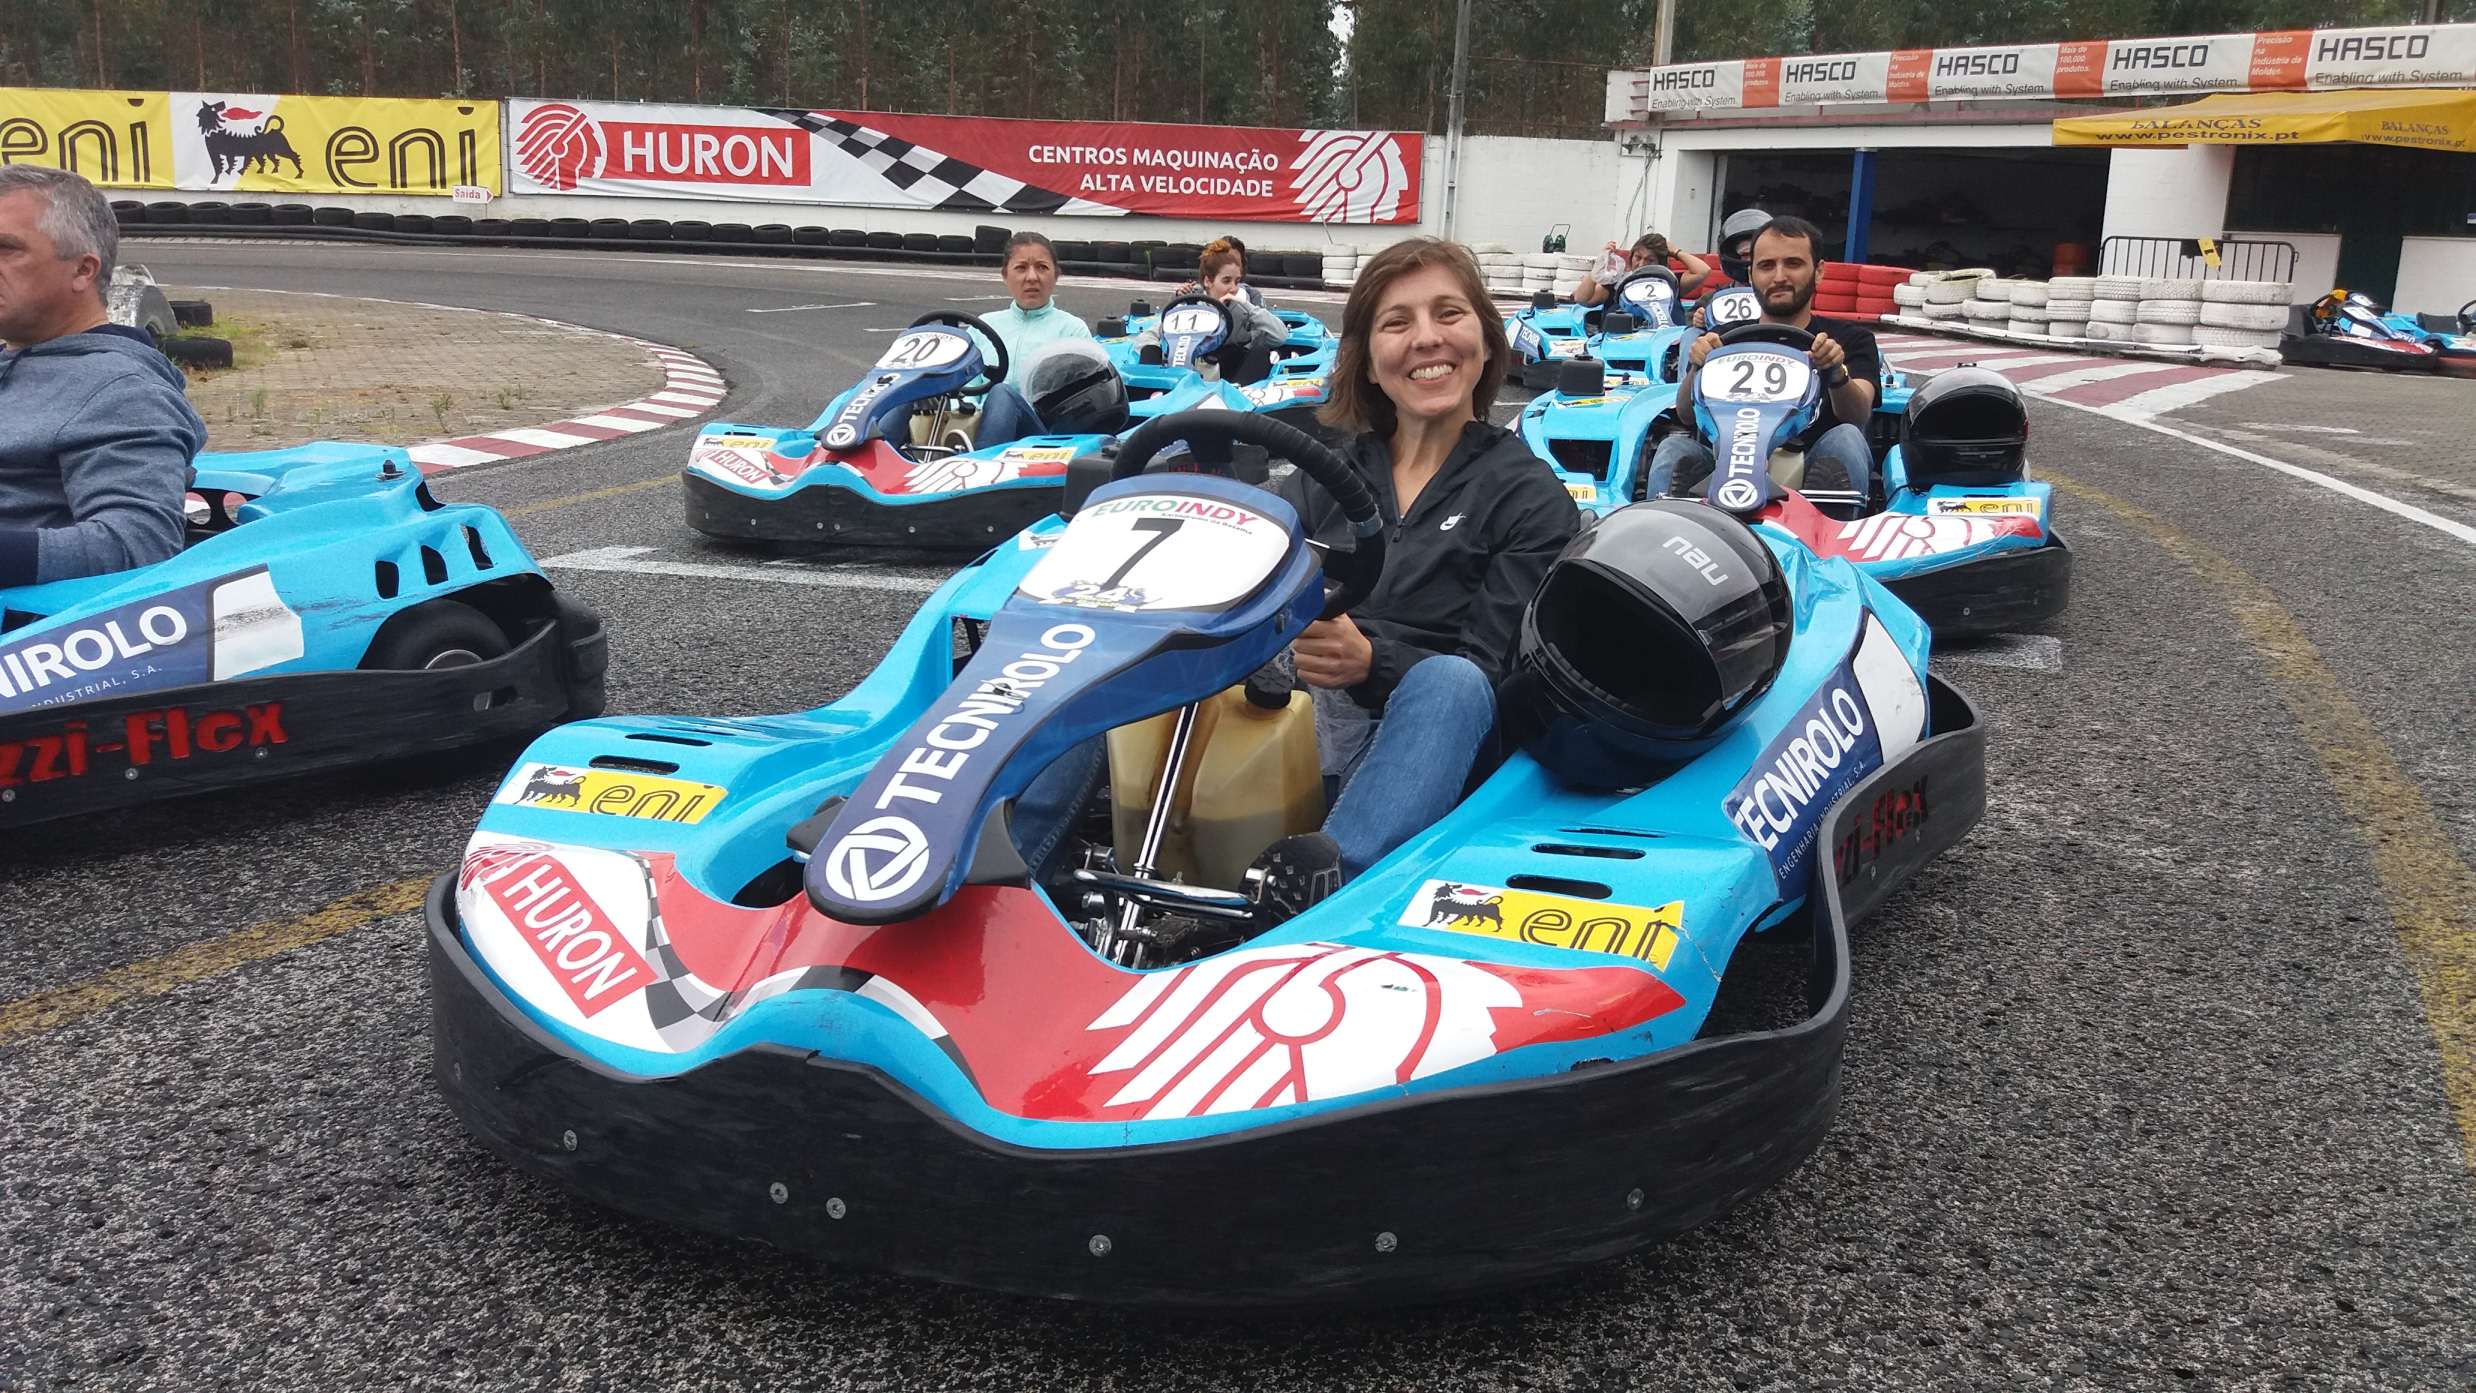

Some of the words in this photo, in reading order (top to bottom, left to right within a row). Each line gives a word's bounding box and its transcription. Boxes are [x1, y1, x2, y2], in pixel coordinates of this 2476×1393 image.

[2112, 44, 2209, 70] HASCO
[2317, 35, 2430, 62] HASCO
[1785, 61, 1857, 83] HASCO
[1936, 53, 2019, 77] HASCO
[1653, 69, 1716, 91] HASCO
[1935, 85, 1978, 97] Enabling
[1981, 84, 2001, 95] with
[2110, 78, 2160, 92] Enabling
[2164, 77, 2188, 89] with
[2315, 72, 2374, 86] Enabling
[2378, 71, 2405, 82] with
[1785, 92, 1820, 103] Enabling
[1823, 89, 1841, 100] with
[325, 105, 477, 188] eni
[2096, 131, 2300, 142] www.pestronix.pt
[623, 128, 793, 179] HURON
[1028, 144, 1127, 166] CENTROS
[1132, 147, 1279, 174] MAQUINAÇÃO
[1080, 174, 1135, 192] ALTA
[1140, 175, 1274, 198] VELOCIDADE
[1645, 284, 1657, 297] 2
[1724, 298, 1752, 320] 26
[891, 337, 941, 362] 20
[714, 450, 767, 482] HURON
[1091, 499, 1259, 527] EUROINDY
[1131, 517, 1185, 592] 7
[1662, 533, 1729, 587] nau
[875, 623, 1096, 810] TECNIROLO
[589, 784, 717, 823] eni
[1778, 823, 1821, 881] ENGENHARIA
[503, 863, 638, 1001] HURON
[1519, 906, 1667, 962] eni
